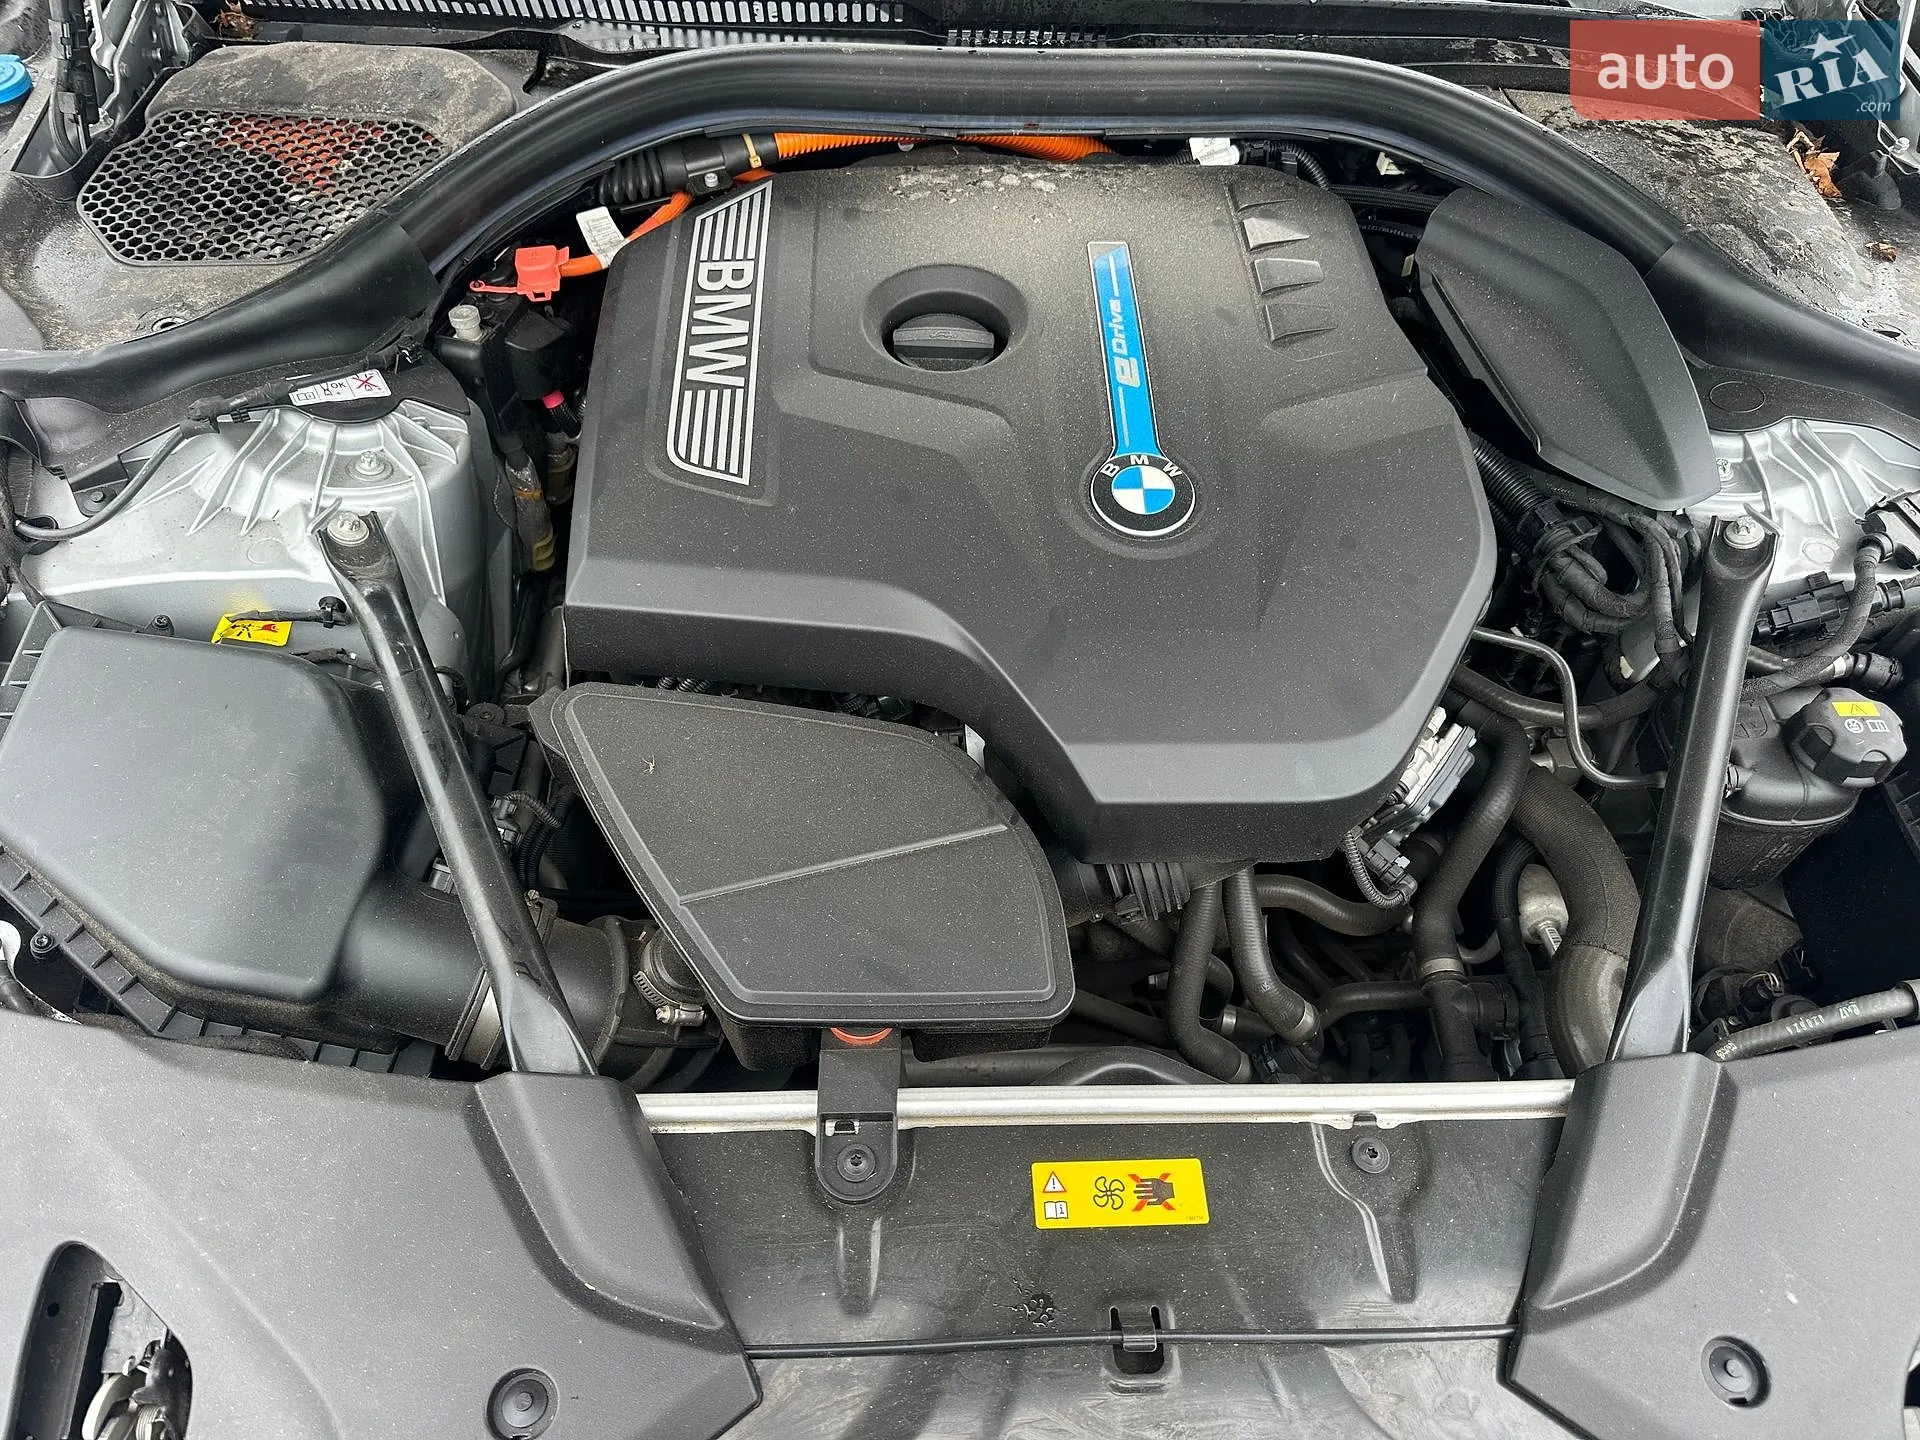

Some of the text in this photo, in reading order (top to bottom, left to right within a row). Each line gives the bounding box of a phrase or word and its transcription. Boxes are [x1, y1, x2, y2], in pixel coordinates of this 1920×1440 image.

[686, 260, 755, 387] BMW
[330, 382, 346, 390] OK
[1101, 454, 1183, 478] BMW
